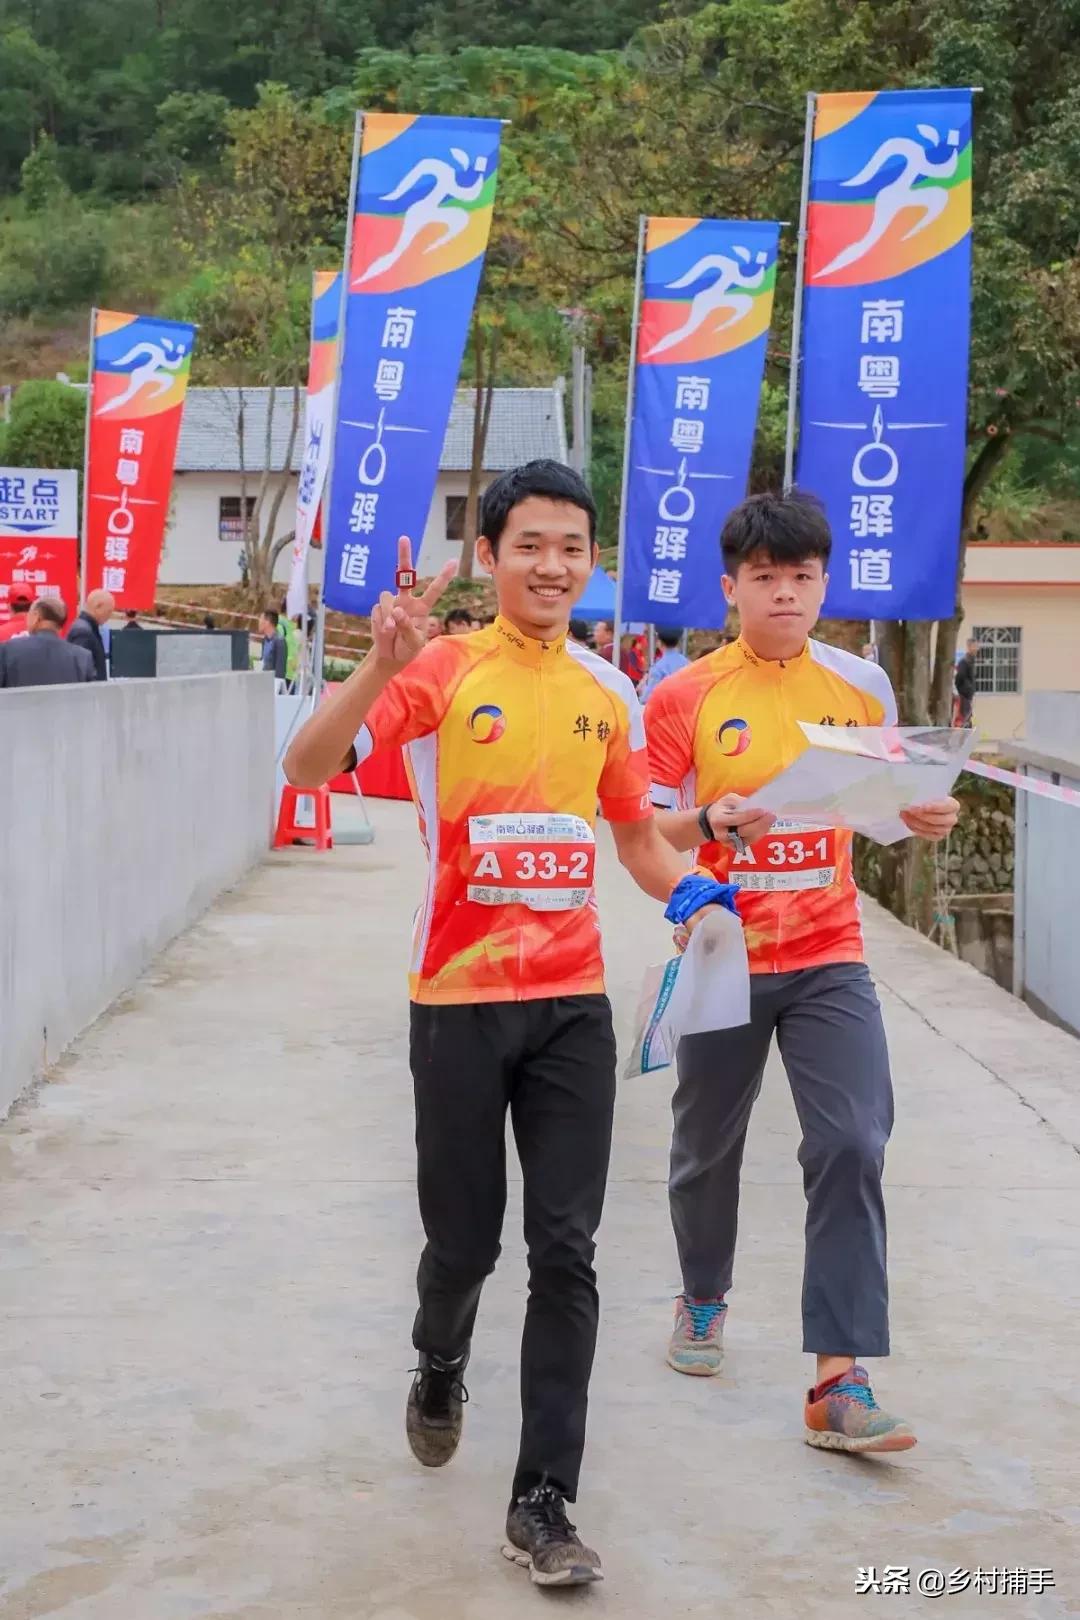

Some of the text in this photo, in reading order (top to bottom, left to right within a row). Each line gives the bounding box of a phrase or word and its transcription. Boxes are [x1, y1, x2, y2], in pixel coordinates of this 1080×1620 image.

[0, 478, 58, 505] 起点
[0, 508, 59, 521] START
[767, 837, 827, 865] 33-1
[474, 851, 588, 880] A 33-2
